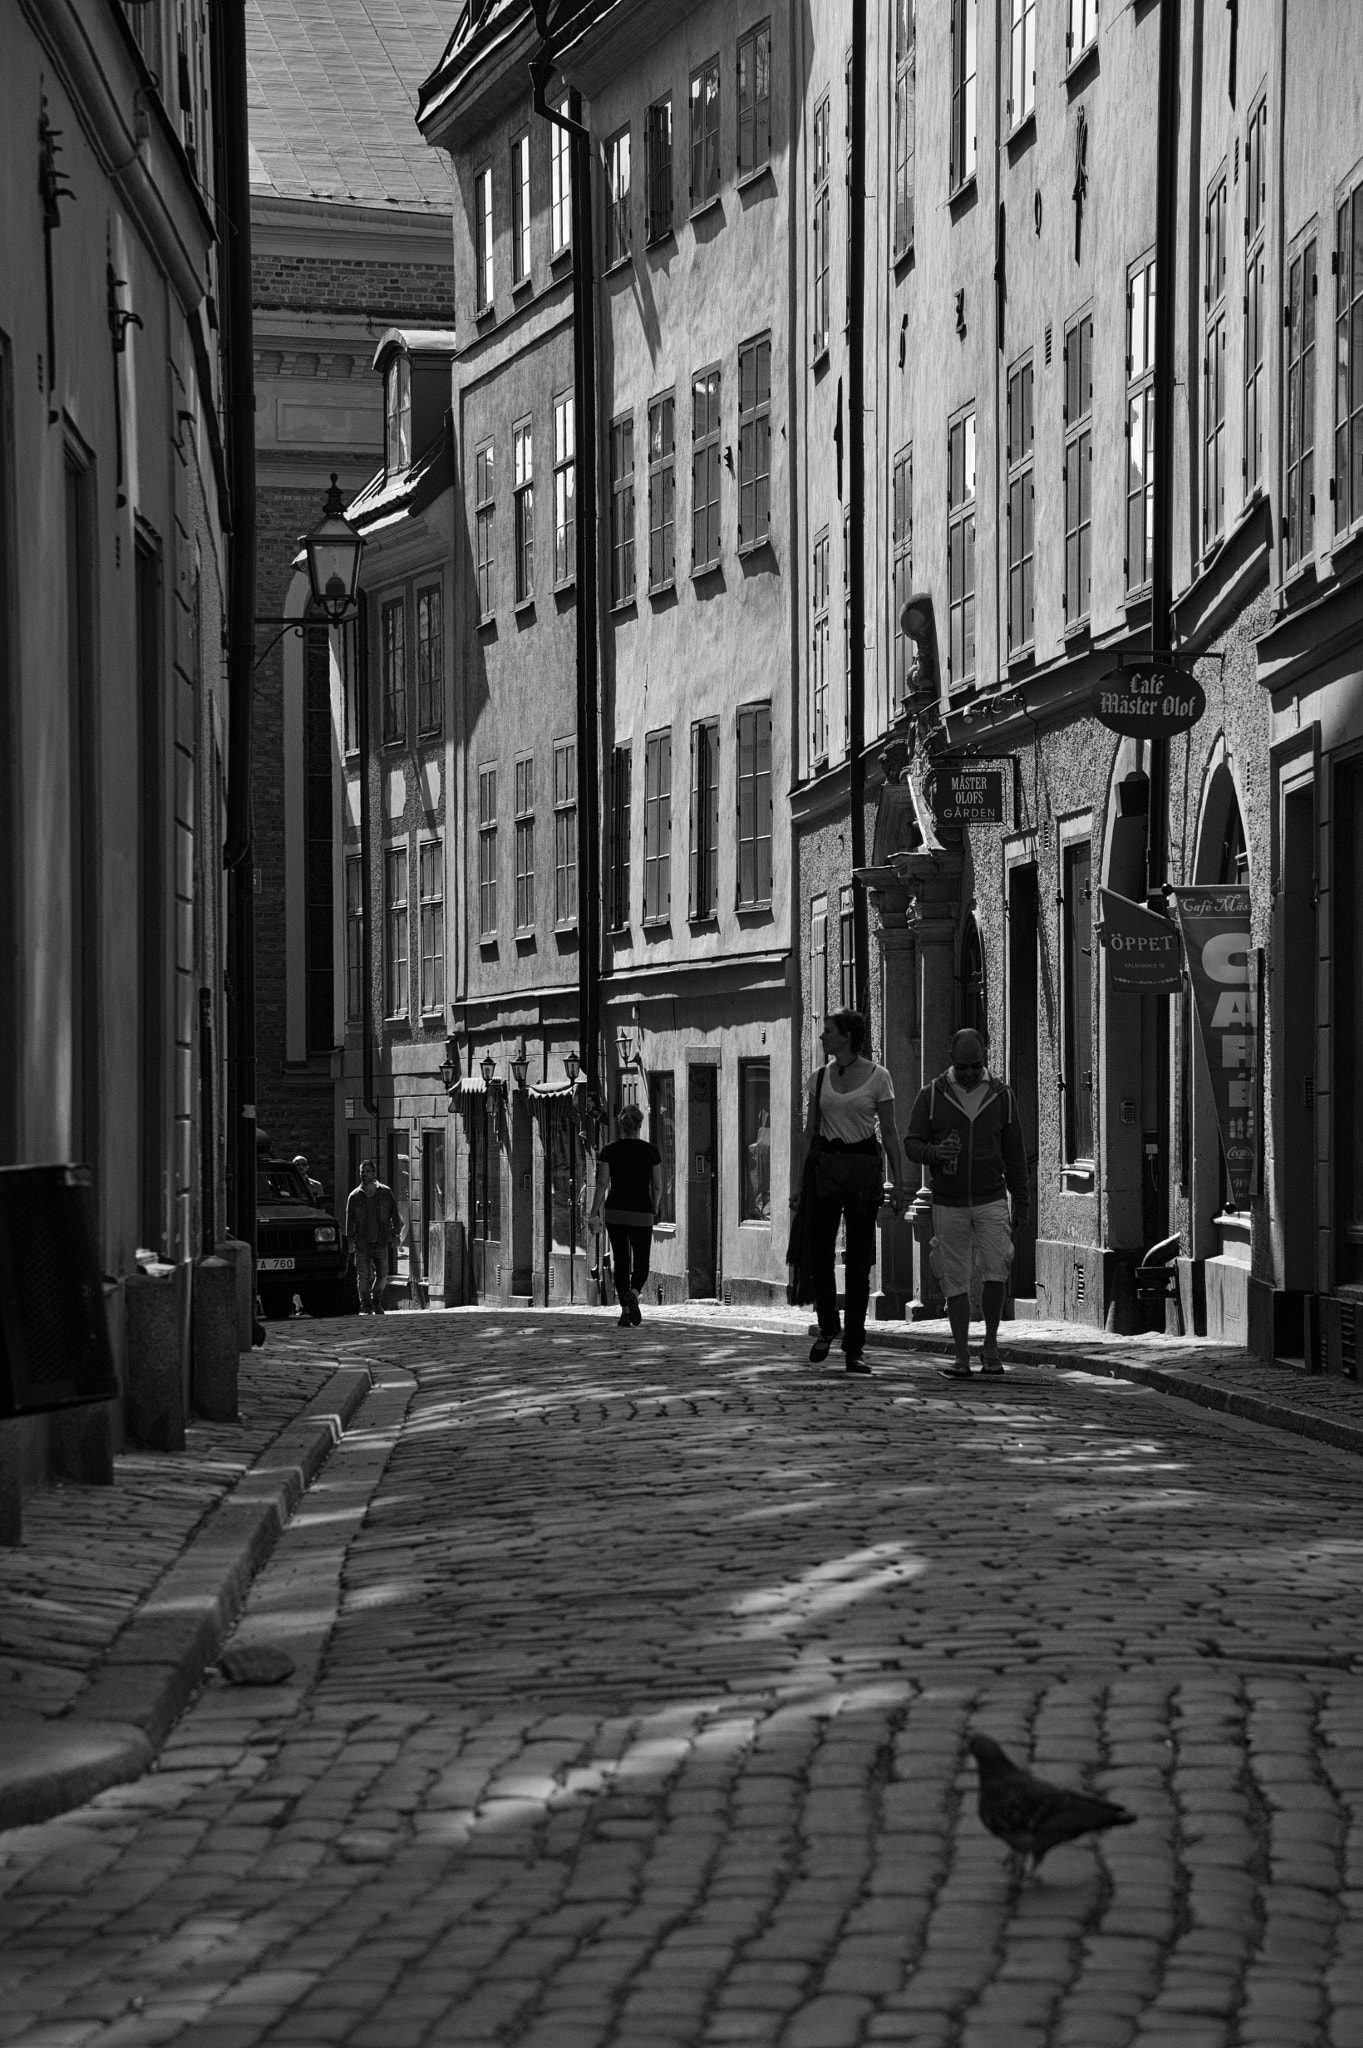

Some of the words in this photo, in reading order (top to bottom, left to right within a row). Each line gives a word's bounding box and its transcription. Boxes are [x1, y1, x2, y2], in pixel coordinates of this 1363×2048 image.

[1130, 672, 1165, 695] Café
[1100, 692, 1157, 715] Mäster
[1161, 695, 1196, 717] Olof
[955, 791, 984, 804] OLOFS
[943, 806, 995, 818] GÅRDEN
[1180, 898, 1213, 917] Café
[1110, 933, 1173, 951] ÖPPET
[273, 1259, 293, 1268] 760
